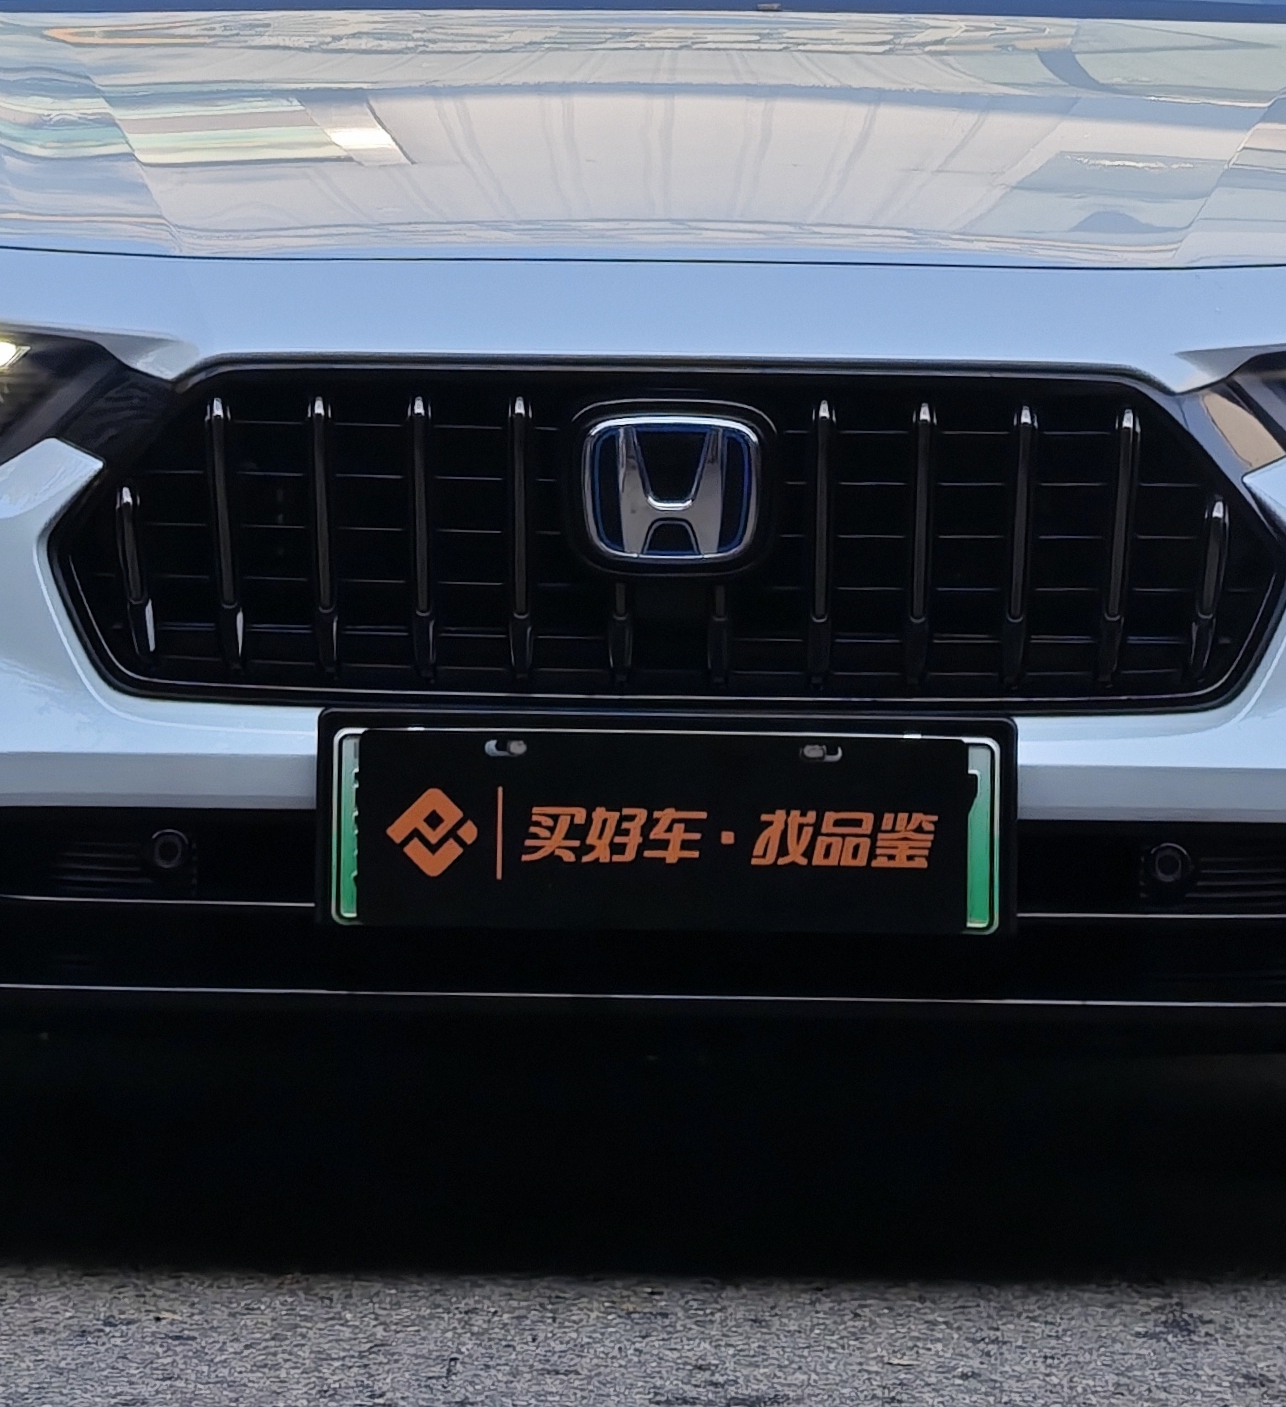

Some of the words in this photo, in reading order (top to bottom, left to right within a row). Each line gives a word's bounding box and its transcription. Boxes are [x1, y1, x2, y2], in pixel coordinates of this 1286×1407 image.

[521, 806, 939, 869] 买好车·找品鉴
